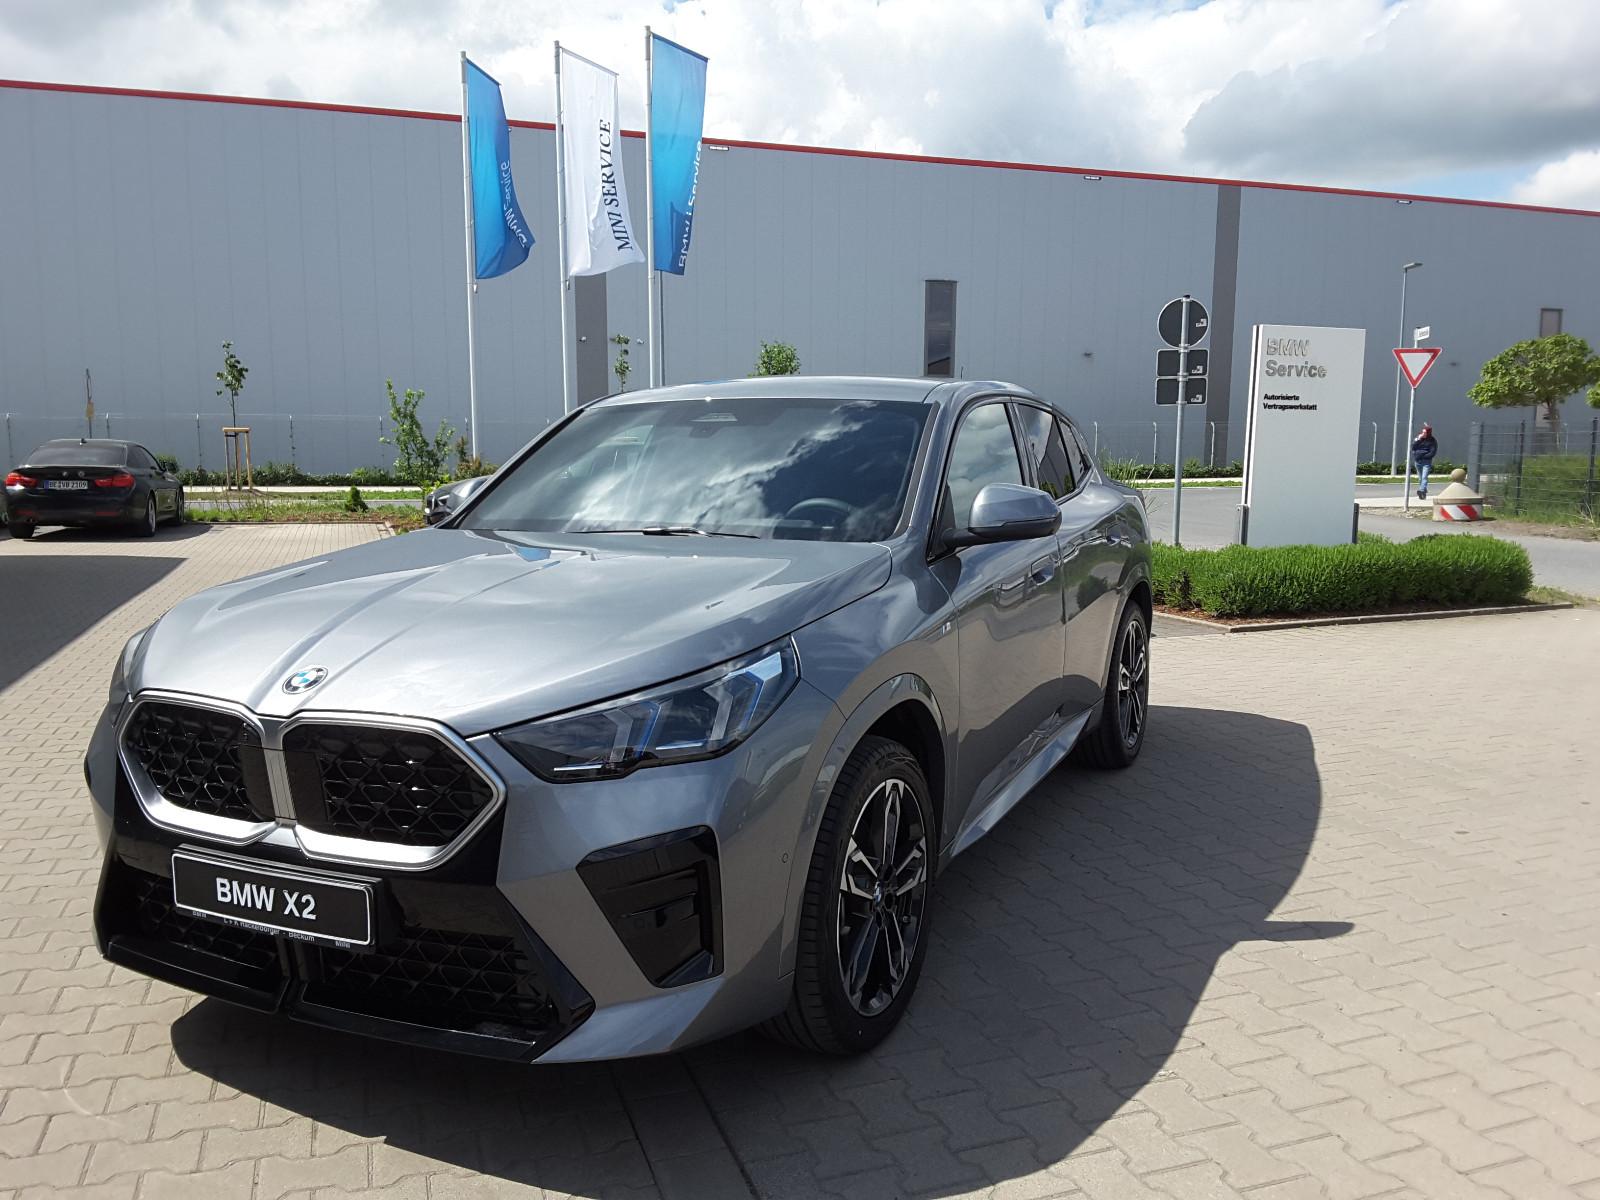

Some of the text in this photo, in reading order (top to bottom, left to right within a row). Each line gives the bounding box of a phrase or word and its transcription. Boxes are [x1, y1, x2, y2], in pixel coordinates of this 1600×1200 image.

[599, 119, 633, 251] MINI SERVICE
[1266, 337, 1310, 356] BMW
[1265, 359, 1328, 378] Service
[1262, 402, 1318, 411] Vertragswerkstatt
[1263, 393, 1300, 401] Autorisierte
[216, 877, 317, 920] BMW X2
